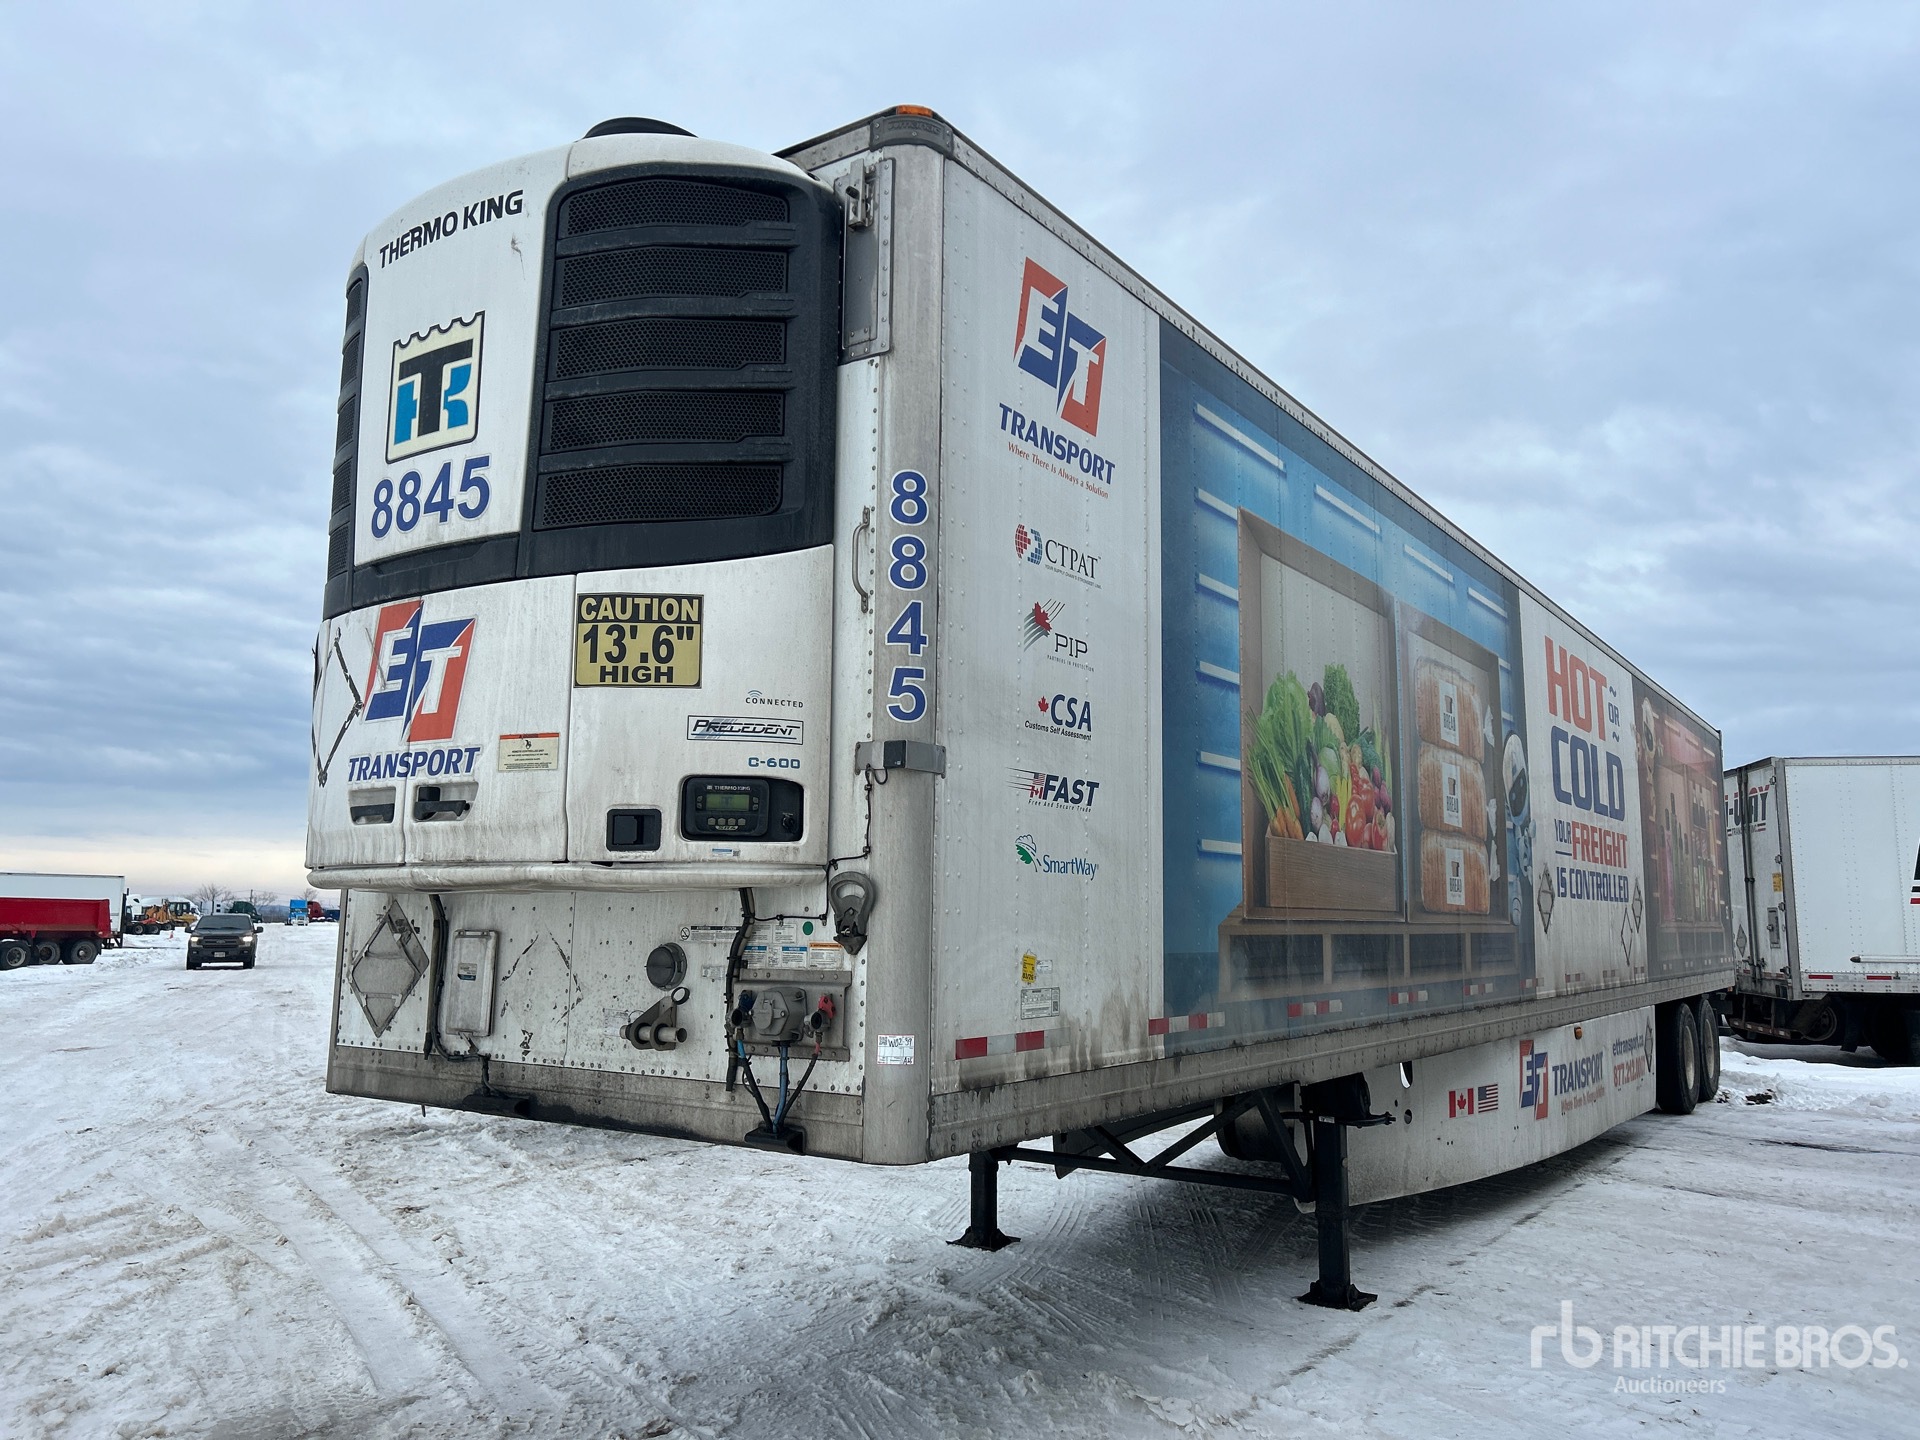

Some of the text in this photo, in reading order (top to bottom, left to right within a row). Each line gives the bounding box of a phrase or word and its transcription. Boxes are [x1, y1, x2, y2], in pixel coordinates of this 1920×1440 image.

[379, 189, 523, 268] THERMO KING
[999, 402, 1116, 485] TRANSPORT
[1008, 441, 1030, 460] Where
[1032, 453, 1049, 470] There
[1051, 464, 1057, 474] Is
[1058, 468, 1079, 486] Always
[1085, 481, 1109, 499] Solution
[371, 455, 490, 539] 8845
[1045, 539, 1098, 579] CTPAT
[581, 597, 699, 621] CAUTION
[1055, 632, 1088, 658] PIP
[600, 666, 674, 683] HIGH
[1544, 635, 1620, 741] HOT OR
[745, 697, 804, 708] CONNECTED
[1051, 694, 1091, 732] CSA
[692, 719, 801, 736] PRECEDENT
[1024, 720, 1092, 741] Customs Self Assessment
[348, 747, 481, 782] TRANSPORT
[748, 757, 801, 769] C-600
[1551, 725, 1625, 821] COLD
[1042, 774, 1100, 806] FAST
[1554, 818, 1628, 869] YOUR FREIGHT
[1043, 854, 1097, 881] SmartWay
[1556, 866, 1629, 903] IS CONTROLLED
[1552, 1051, 1604, 1096] TRANSPORT
